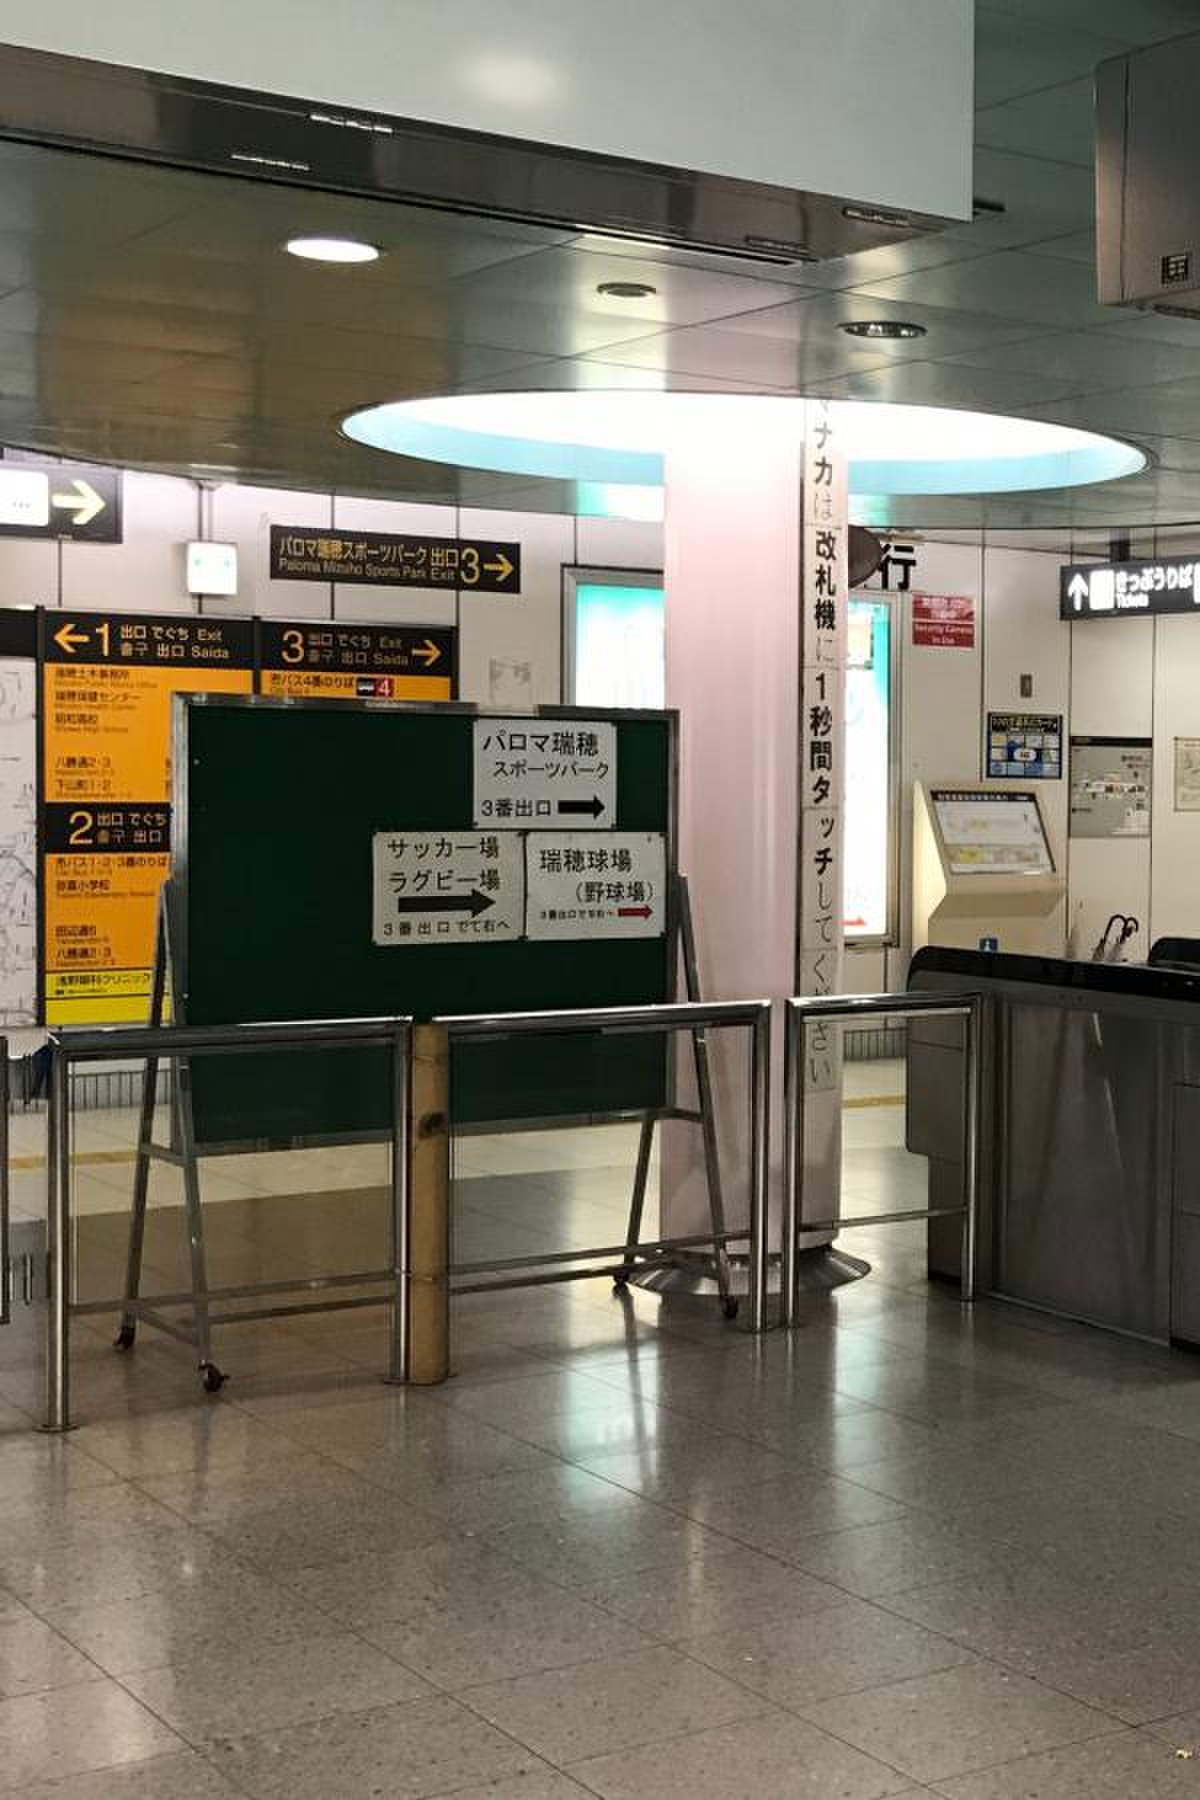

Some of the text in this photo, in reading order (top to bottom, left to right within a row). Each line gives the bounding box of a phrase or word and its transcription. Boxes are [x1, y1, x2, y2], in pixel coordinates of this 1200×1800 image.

[431, 547, 459, 567] 出口
[461, 547, 480, 584] 3
[431, 567, 455, 581] Exit
[95, 623, 222, 657] 1 出口 でぐち Exit
[281, 630, 305, 663] 3
[307, 633, 333, 647] 出口
[378, 679, 392, 698] 4
[482, 729, 599, 757] パロマ瑞穂
[809, 399, 836, 1083] ナカは改札機に1秒間タッチしてくさい
[481, 799, 551, 817] 3番出口
[69, 811, 167, 845] 2 出口 でぐち
[133, 829, 161, 844] 出口
[387, 837, 499, 859] サッカー場
[540, 848, 632, 873] 瑞穂球場
[388, 869, 500, 893] ラグビー場
[384, 919, 510, 936] 3番出口でて右へ
